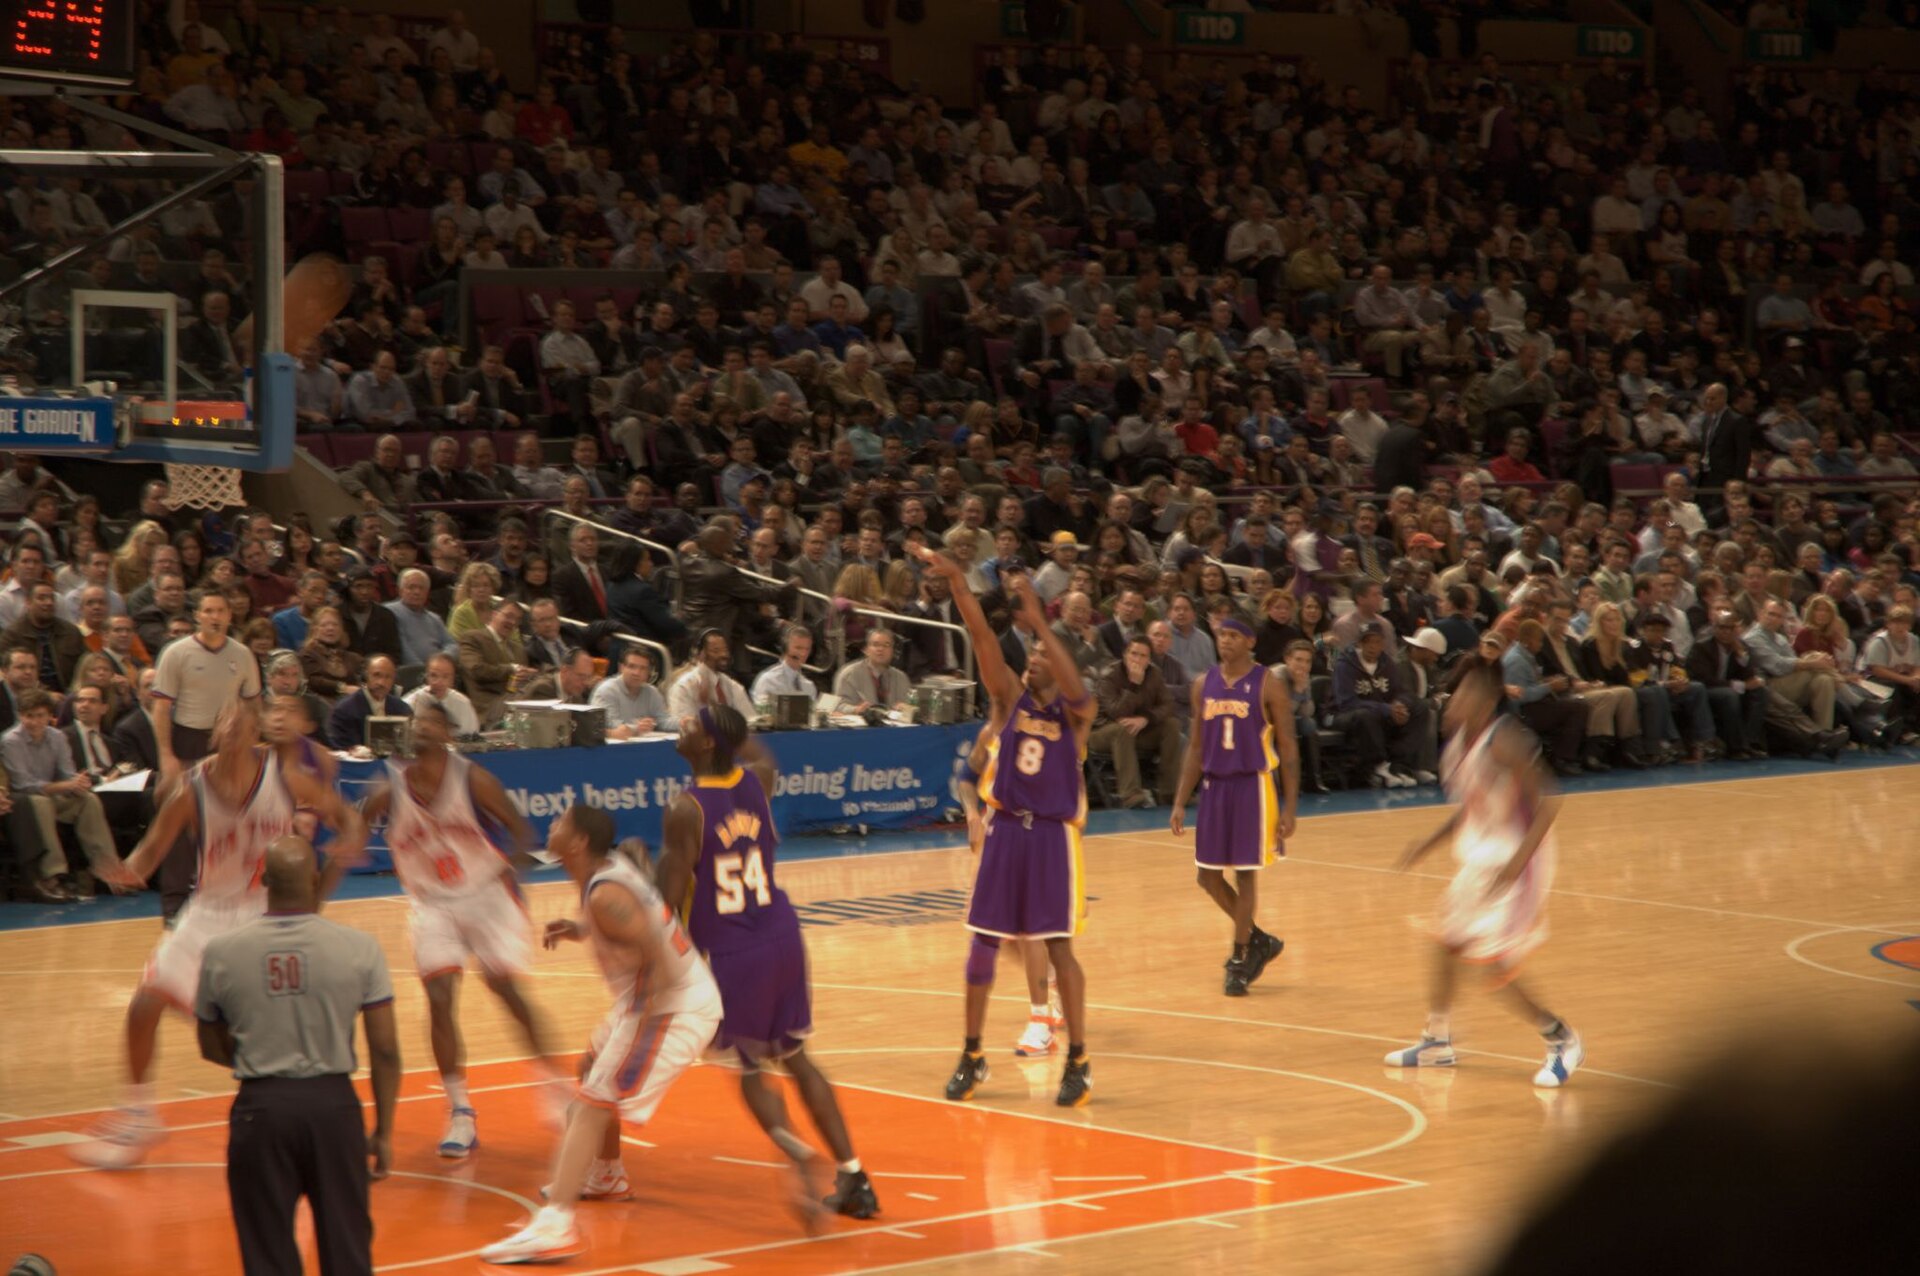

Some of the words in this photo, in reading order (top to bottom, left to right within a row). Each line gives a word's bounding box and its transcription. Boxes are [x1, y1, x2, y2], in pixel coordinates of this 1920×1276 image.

[14, 0, 105, 60] 24
[22, 407, 97, 443] GARDEN
[1221, 717, 1236, 750] 1
[1015, 736, 1046, 776] 8
[504, 784, 577, 818] Next
[581, 778, 649, 811] best
[772, 764, 848, 801] being
[851, 763, 922, 793] here.
[713, 845, 772, 915] 54
[268, 955, 300, 992] 50
